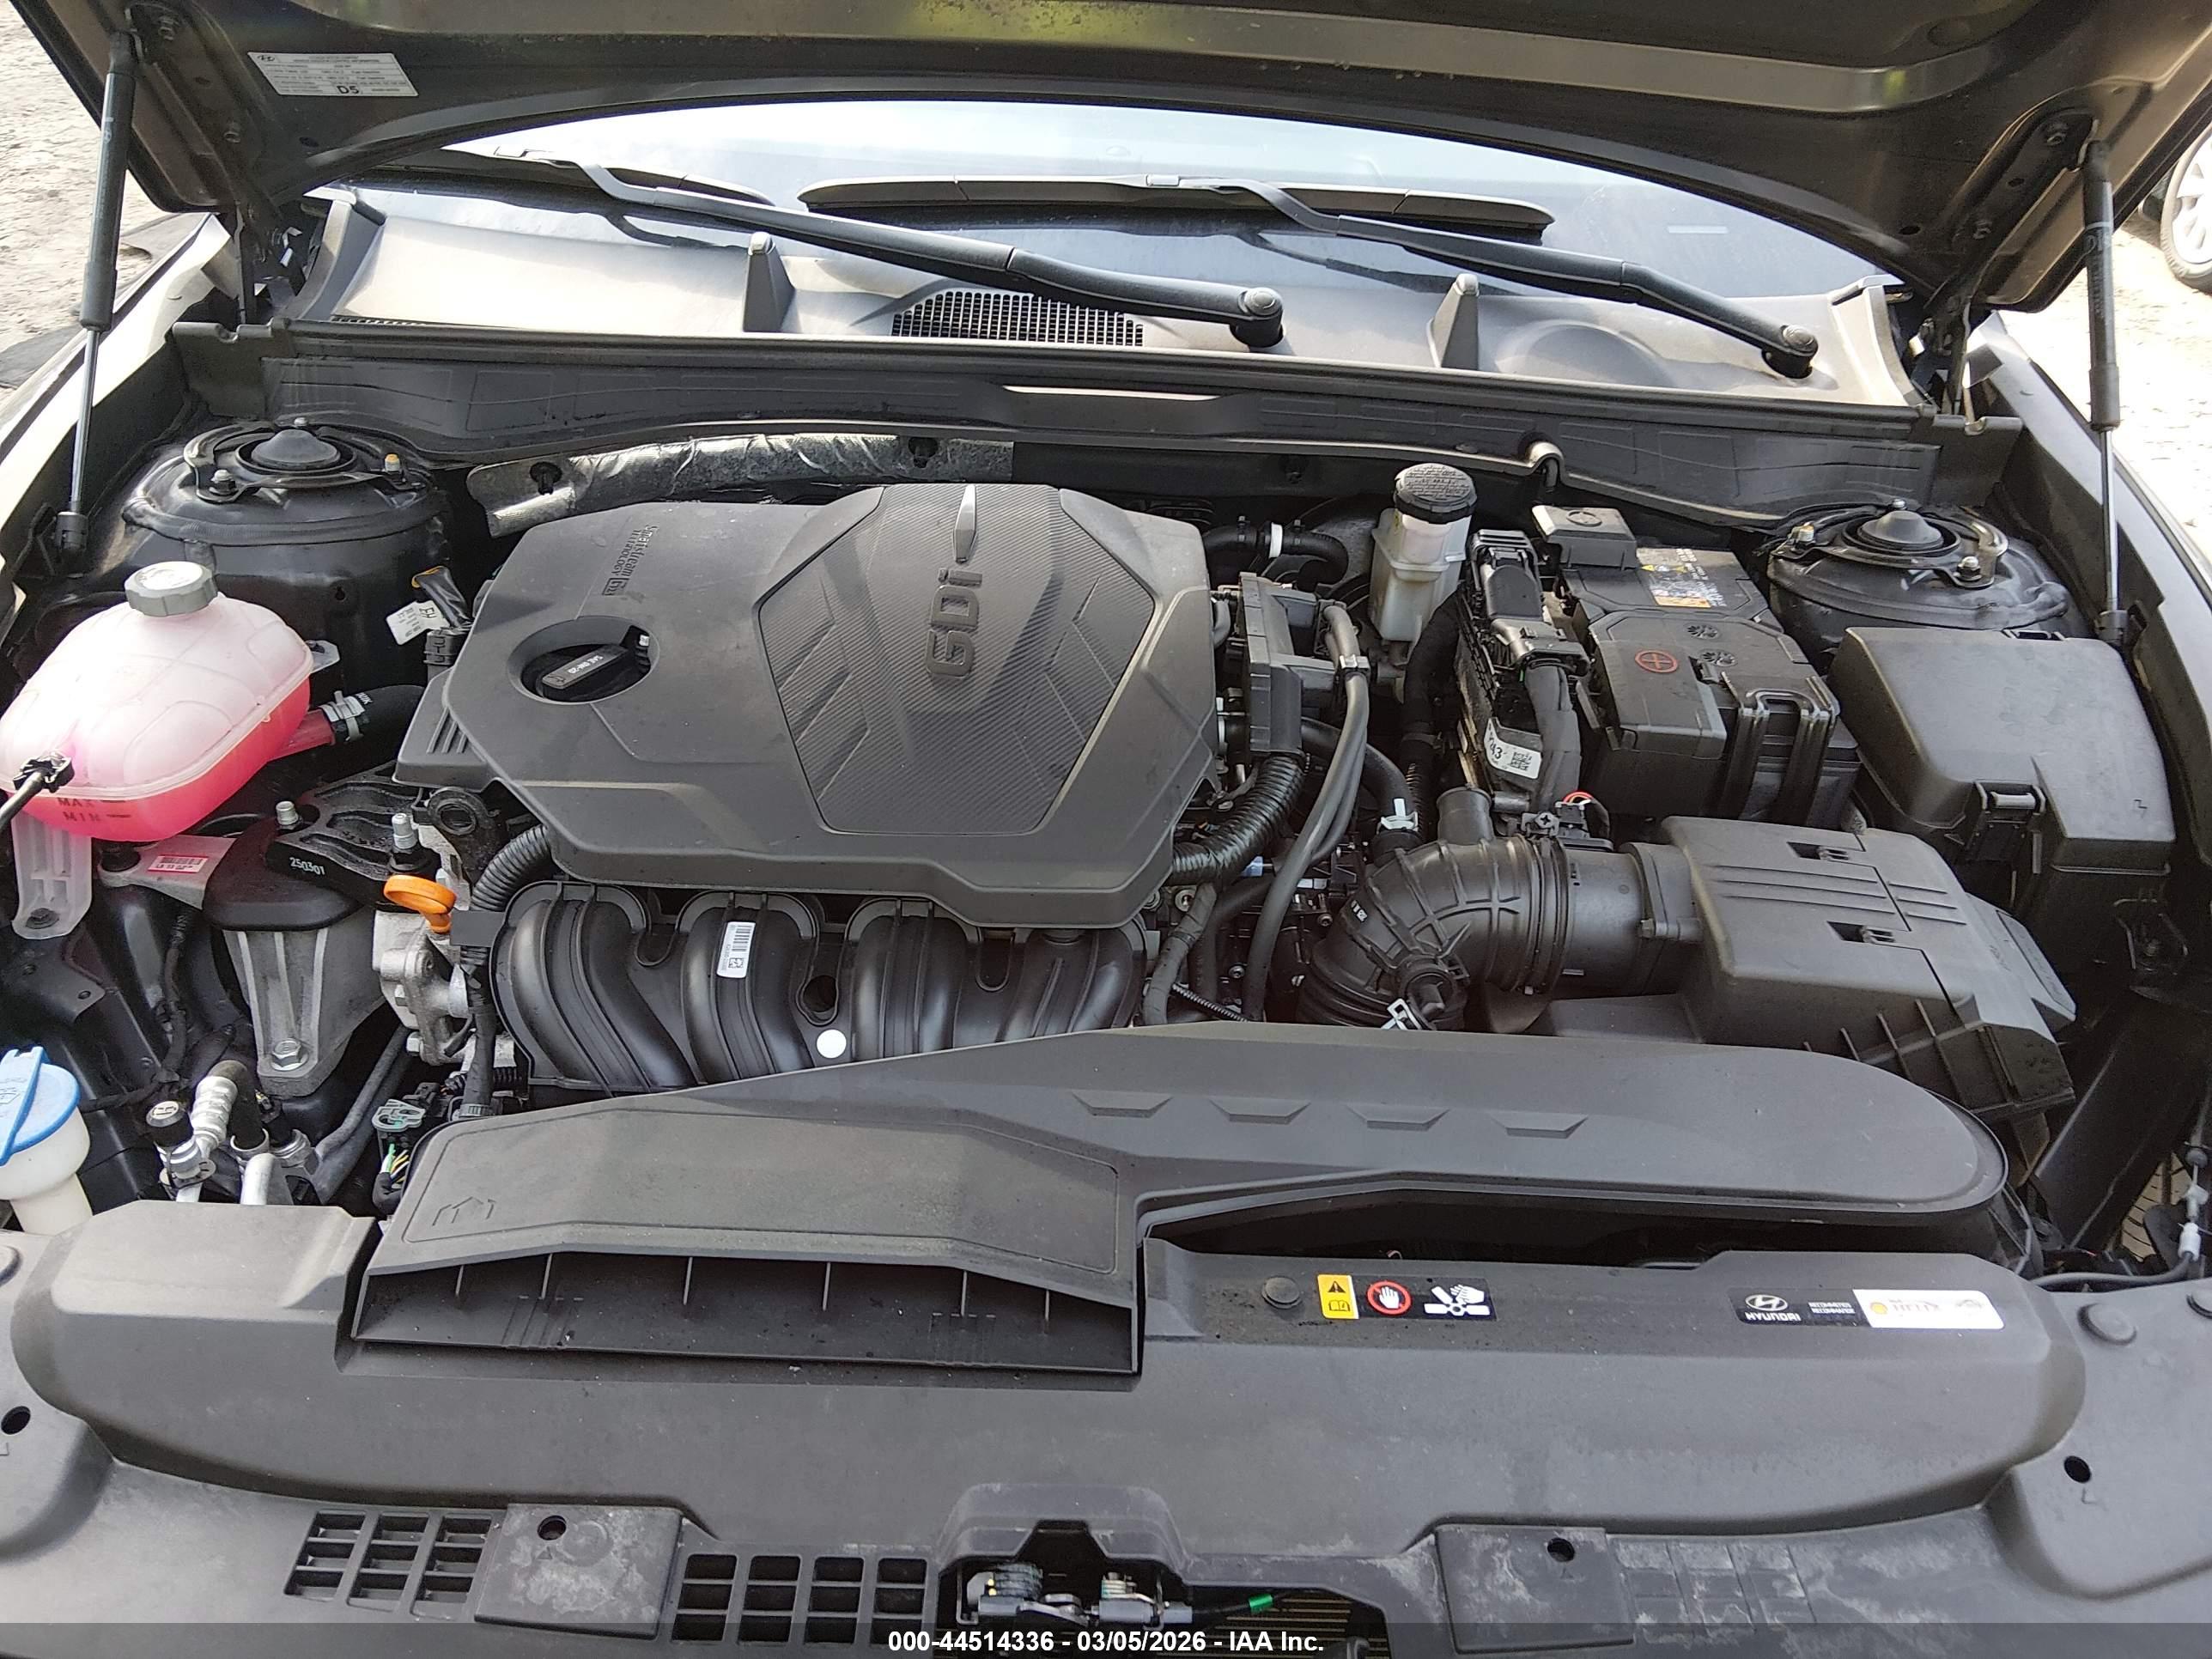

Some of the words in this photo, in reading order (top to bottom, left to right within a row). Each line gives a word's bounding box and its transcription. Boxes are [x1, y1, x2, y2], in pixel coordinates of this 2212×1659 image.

[336, 85, 360, 94] D5
[926, 567, 983, 677] GDi
[57, 797, 95, 807] MAX
[63, 811, 102, 822] MIN
[289, 857, 325, 875] 250301
[1744, 1312, 1802, 1322] HYUNDAI
